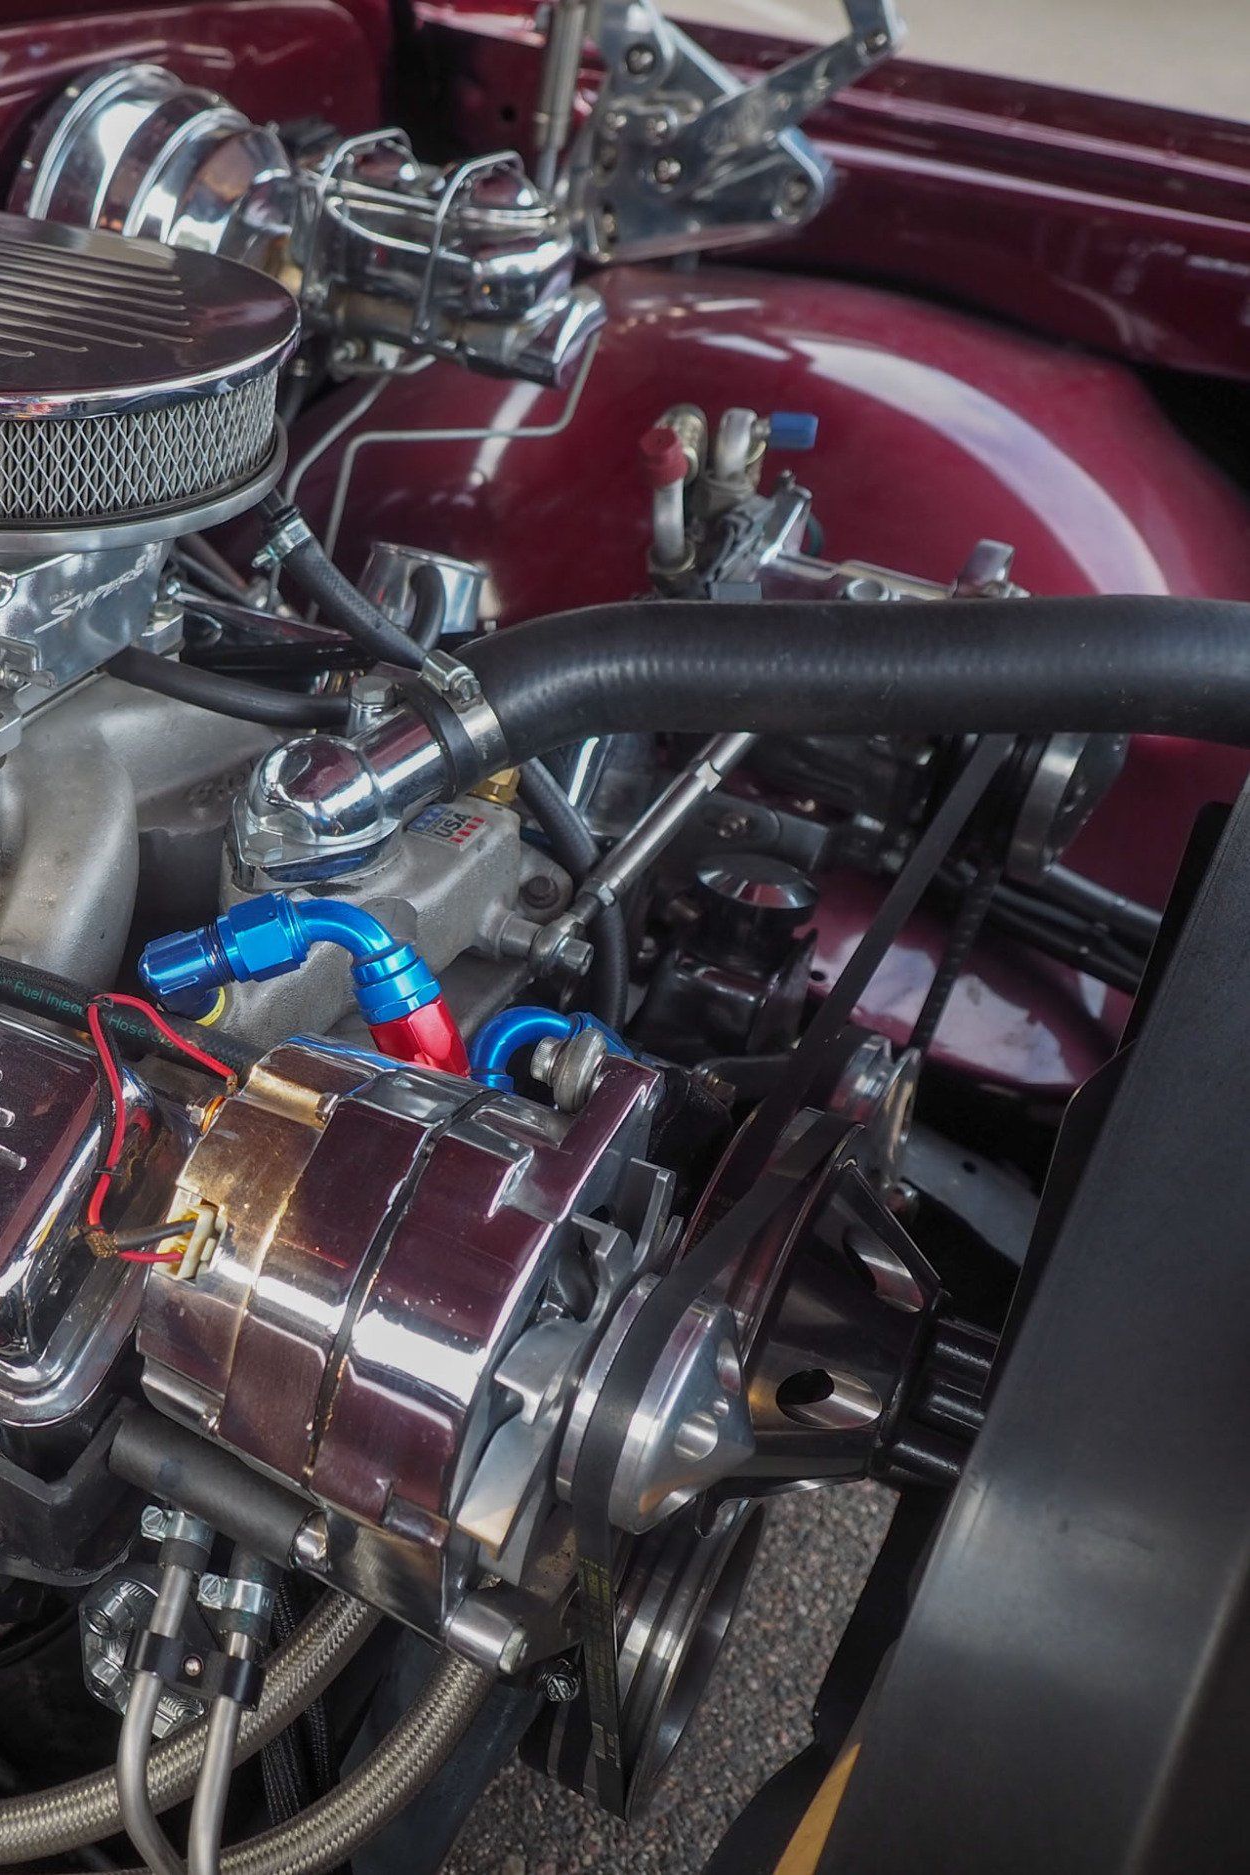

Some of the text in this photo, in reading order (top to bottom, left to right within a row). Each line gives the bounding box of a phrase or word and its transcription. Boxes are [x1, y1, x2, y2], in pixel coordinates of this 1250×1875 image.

[434, 812, 472, 838] USA
[14, 980, 45, 1002] Fuel
[108, 1014, 148, 1038] Hose
